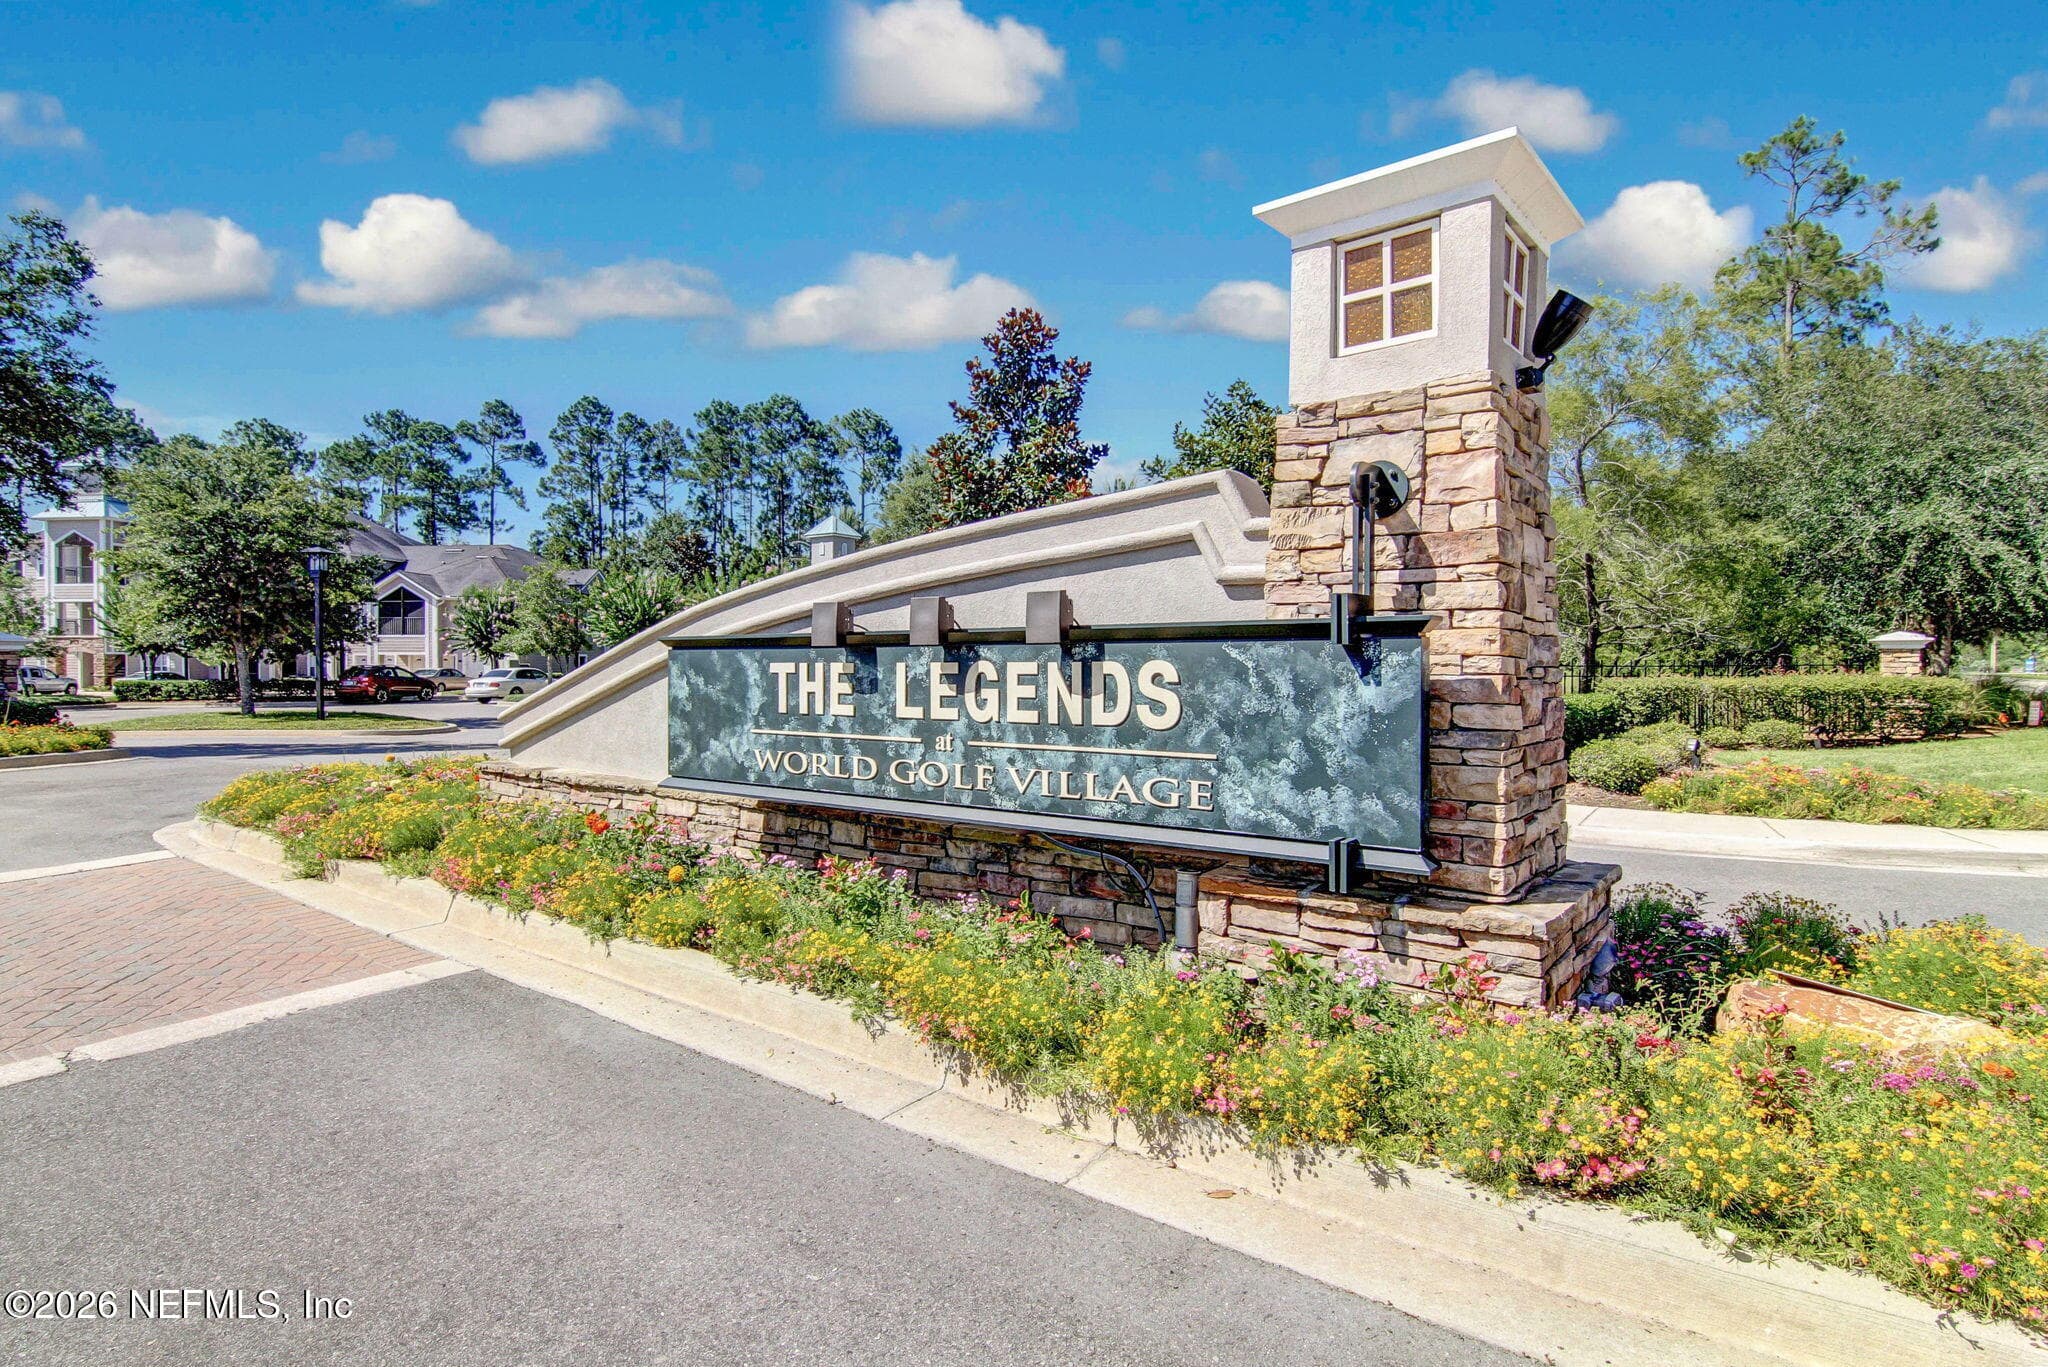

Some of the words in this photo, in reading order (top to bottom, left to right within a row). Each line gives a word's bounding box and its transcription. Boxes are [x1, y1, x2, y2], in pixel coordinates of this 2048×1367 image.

[769, 661, 857, 717] THE
[895, 659, 1183, 731] LEGENDS
[934, 732, 955, 752] at
[753, 749, 879, 781] WORLD
[889, 758, 995, 792] GOLF
[1006, 766, 1215, 812] VILLAGE
